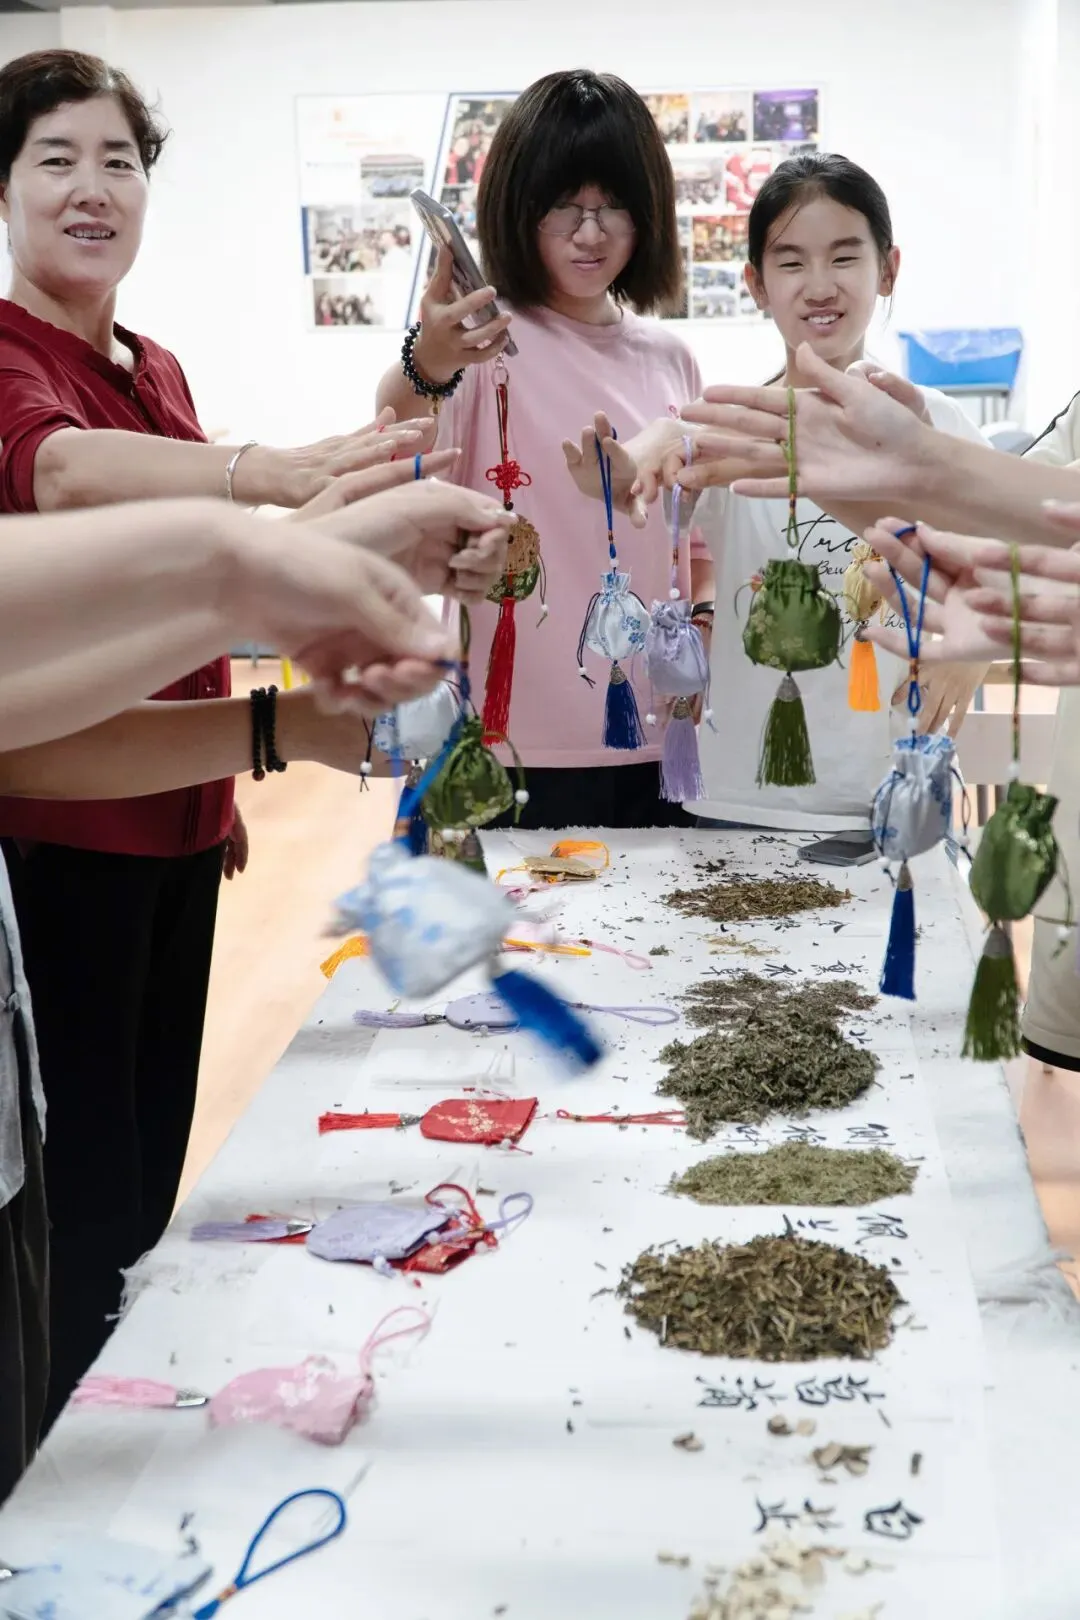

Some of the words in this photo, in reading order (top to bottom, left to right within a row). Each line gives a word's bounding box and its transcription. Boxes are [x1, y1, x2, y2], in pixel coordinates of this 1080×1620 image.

[782, 1213, 909, 1245] 佩兰
[695, 1374, 887, 1412] 菖蒲
[753, 1494, 925, 1541] 白芷
